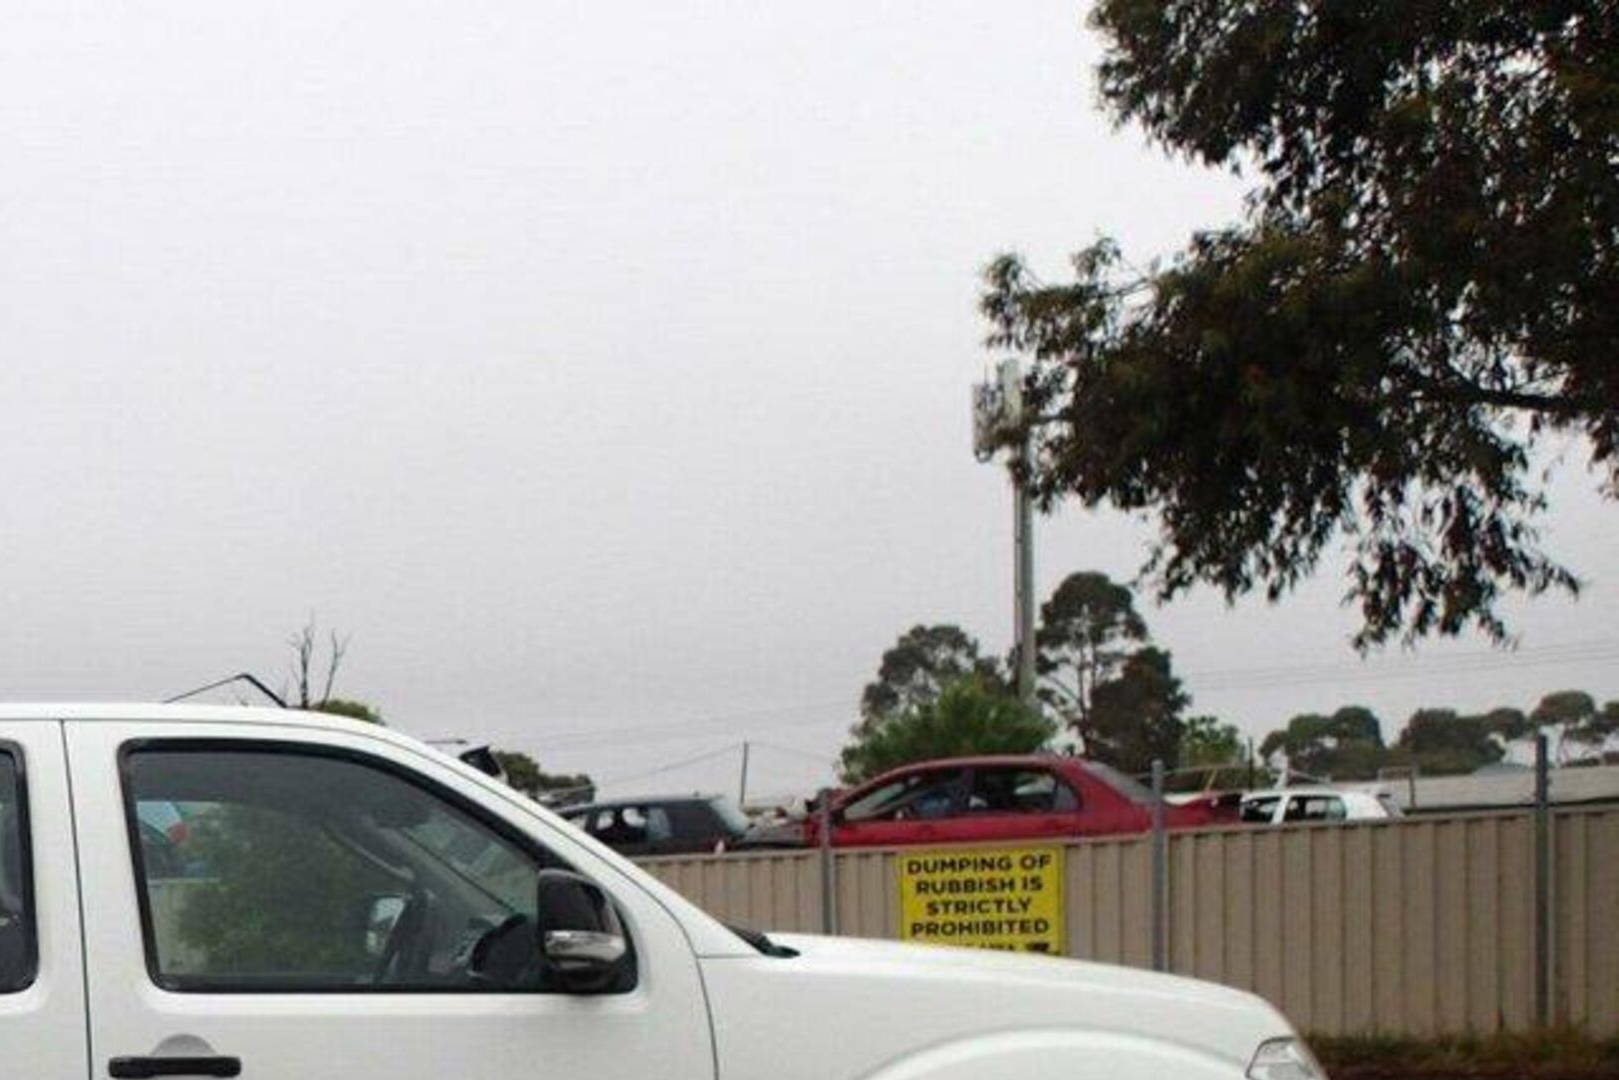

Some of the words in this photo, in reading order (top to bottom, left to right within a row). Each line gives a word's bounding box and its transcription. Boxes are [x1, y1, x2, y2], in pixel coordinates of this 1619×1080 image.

[908, 856, 1013, 875] DUMPING
[1020, 854, 1052, 871] OF
[916, 877, 1015, 895] RUBBISH
[1022, 875, 1043, 891] IS
[927, 897, 1031, 916] STRICTLY
[911, 918, 1049, 937] PROHIBITED
